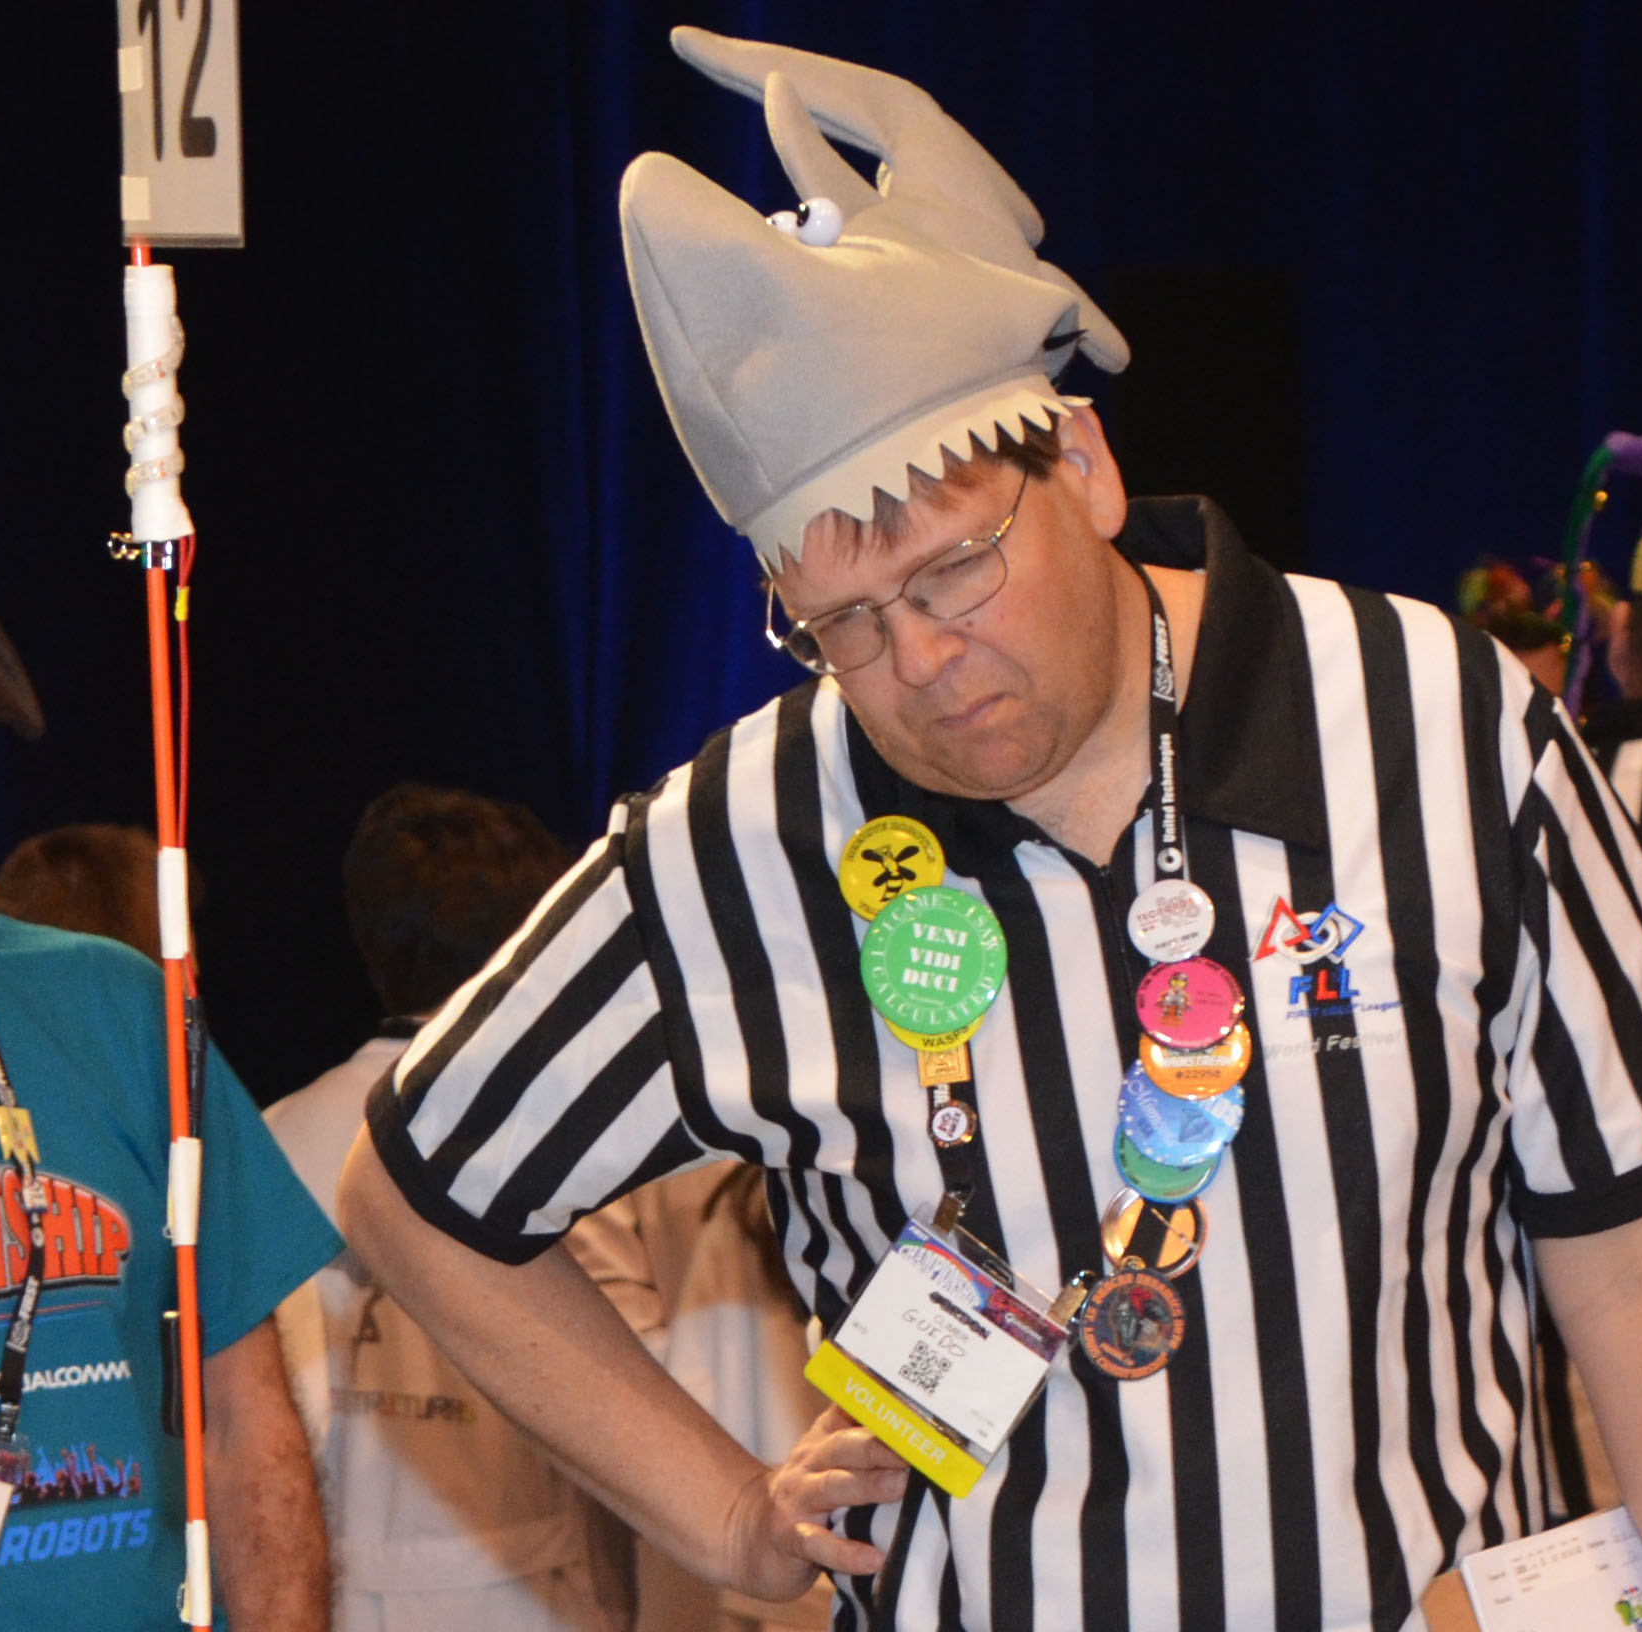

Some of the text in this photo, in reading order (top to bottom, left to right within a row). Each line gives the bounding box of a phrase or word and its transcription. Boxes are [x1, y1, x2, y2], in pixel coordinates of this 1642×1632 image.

[138, 0, 217, 162] 12
[912, 922, 968, 948] VENI
[910, 947, 962, 971] VIDI
[870, 966, 996, 1025] CALCULATED
[901, 967, 959, 993] DUCI
[1289, 967, 1360, 1006] FLL
[844, 1376, 948, 1465] VOLUNTEER
